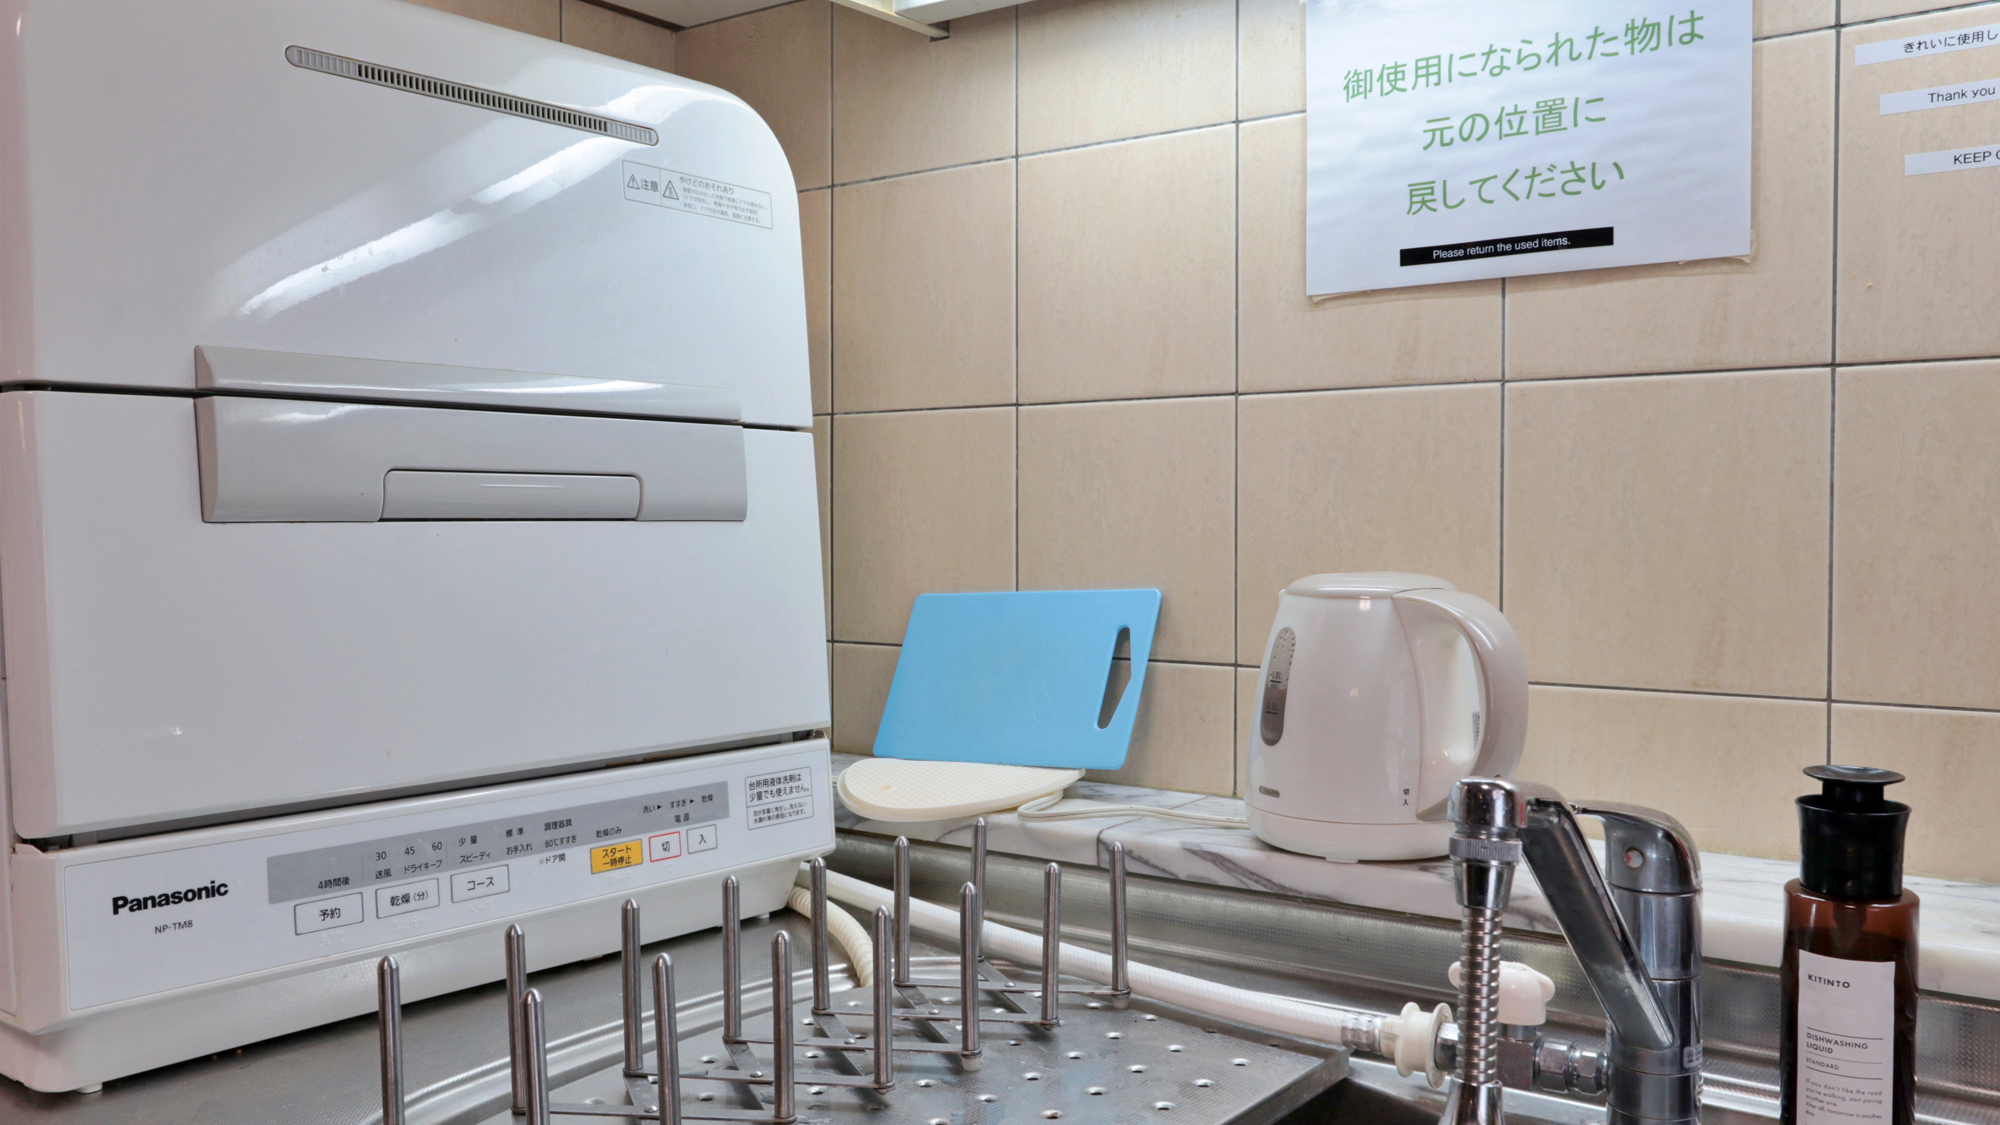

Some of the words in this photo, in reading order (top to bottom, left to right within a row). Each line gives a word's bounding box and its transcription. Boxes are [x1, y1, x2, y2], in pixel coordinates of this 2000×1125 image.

[1903, 29, 1999, 53] きれいに使用し
[1342, 9, 1705, 103] 御使用になられた物は
[1928, 89, 1968, 104] Thank
[1971, 86, 1996, 99] you
[1421, 96, 1607, 151] 元の位置に
[1953, 150, 1992, 165] KEEP
[640, 178, 660, 193] 注意
[679, 175, 735, 195] やけどのおそれあり
[1405, 160, 1626, 216] 戻してください
[1432, 245, 1465, 260] Please
[1466, 243, 1495, 257] return
[1496, 241, 1513, 254] the
[1514, 238, 1539, 252] used
[1540, 235, 1571, 249] items.
[749, 773, 802, 791] 台所用液体洗剤は
[749, 784, 810, 803] 少量でも使えません。
[1403, 787, 1411, 796] 切
[642, 805, 655, 814] 洗い
[669, 798, 688, 809] すすぎ
[701, 793, 714, 804] 乾燥
[1402, 798, 1410, 807] 入
[544, 818, 573, 832] 調理器具
[674, 812, 690, 824] 電源
[505, 826, 525, 839] 標準
[595, 826, 623, 839] 乾燥のみ
[698, 834, 708, 845] 入
[458, 835, 478, 847] 少量
[506, 841, 533, 856] お手入れ
[661, 841, 671, 853] 切
[375, 851, 387, 862] 30
[404, 846, 416, 856] 45
[431, 841, 443, 851] 60
[459, 851, 492, 864] スピーディ
[544, 852, 566, 865] ドア開
[602, 845, 632, 859] スタート
[404, 858, 443, 874] ドライキープ
[602, 856, 632, 868] 一時停止
[374, 867, 393, 880] 送風
[317, 875, 351, 891] 4時間後
[466, 876, 496, 892] コース
[111, 880, 230, 915] Panasonic
[318, 906, 342, 922] 予約
[154, 919, 195, 935] NP-TM8
[1807, 973, 1851, 989] KITINTO
[1806, 1032, 1869, 1050] DISHWASHING
[1806, 1042, 1834, 1055] LIQUID
[1805, 1056, 1840, 1071] STANDARD
[1810, 1080, 1822, 1088] you
[1823, 1083, 1840, 1092] don't
[1862, 1097, 1883, 1105] paving
[1826, 1108, 1855, 1118] tomorrow
